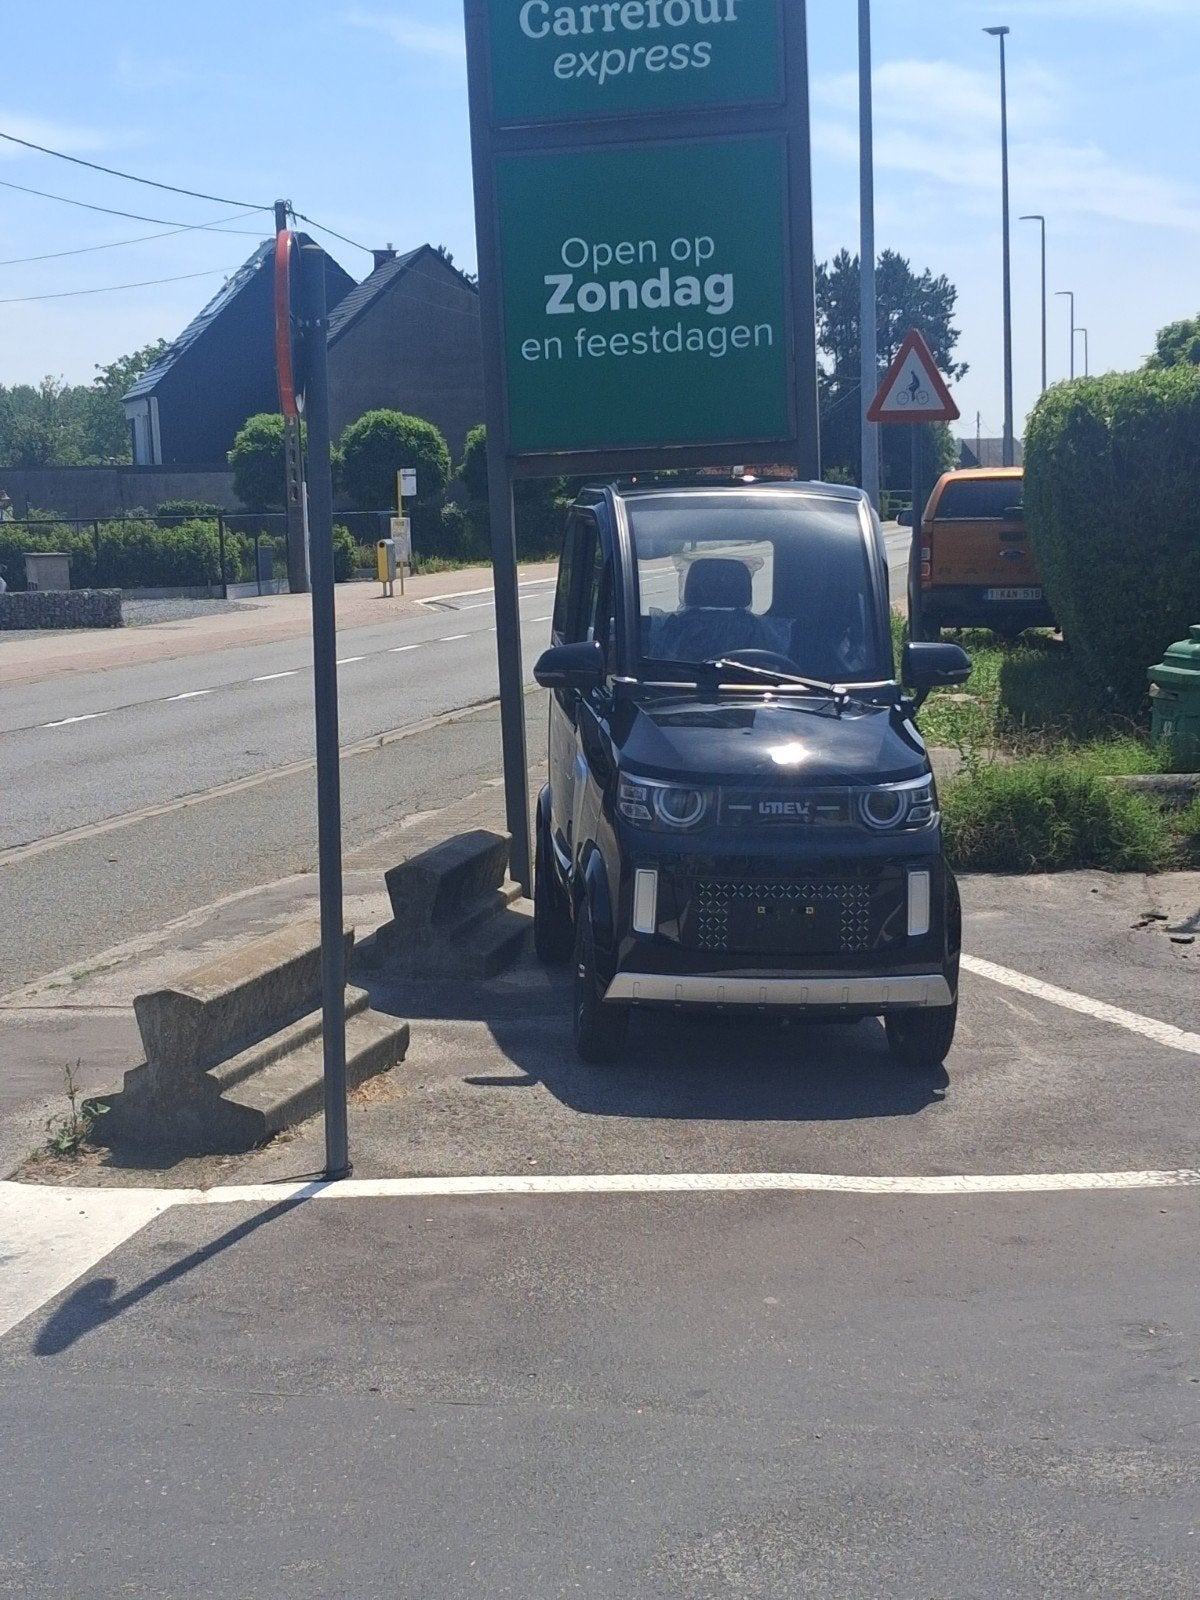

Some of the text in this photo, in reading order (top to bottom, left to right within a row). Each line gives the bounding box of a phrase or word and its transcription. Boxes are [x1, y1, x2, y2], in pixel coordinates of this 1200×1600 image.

[518, 0, 738, 39] Carrefour
[553, 41, 712, 85] express
[561, 235, 715, 274] Open op
[544, 267, 734, 315] Zondag
[521, 322, 773, 361] en feestdagen
